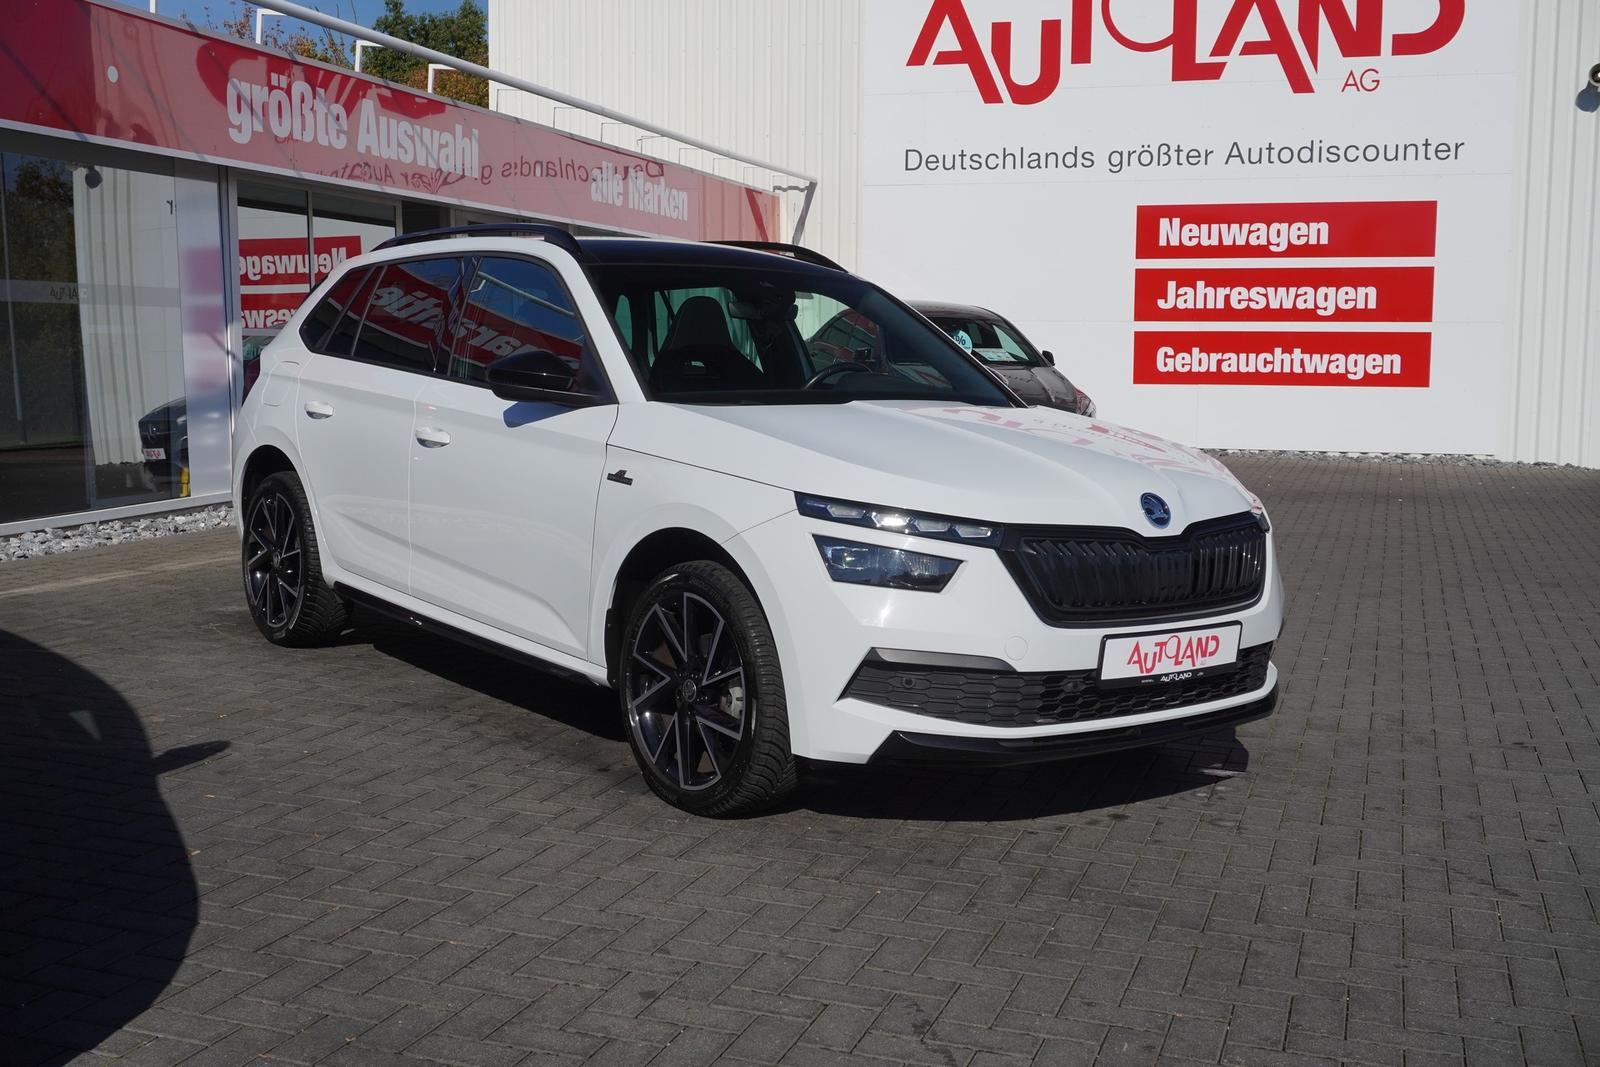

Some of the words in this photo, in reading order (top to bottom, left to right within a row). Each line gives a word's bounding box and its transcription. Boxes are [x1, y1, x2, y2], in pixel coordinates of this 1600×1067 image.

[1342, 68, 1381, 93] AG
[226, 72, 348, 150] größte
[357, 98, 480, 178] Auswahl
[904, 145, 1095, 172] Deutschlands
[1107, 142, 1214, 174] größter
[1224, 137, 1465, 165] Autodiscounter
[591, 160, 624, 207] alle
[629, 170, 688, 221] Marken
[1158, 217, 1329, 252] Neuwagen
[1156, 280, 1377, 317] Jahreswagen
[1155, 346, 1402, 380] Gebrauchtwagen
[1127, 634, 1220, 674] AUTOLAND
[1160, 672, 1193, 682] AUTOLAND
